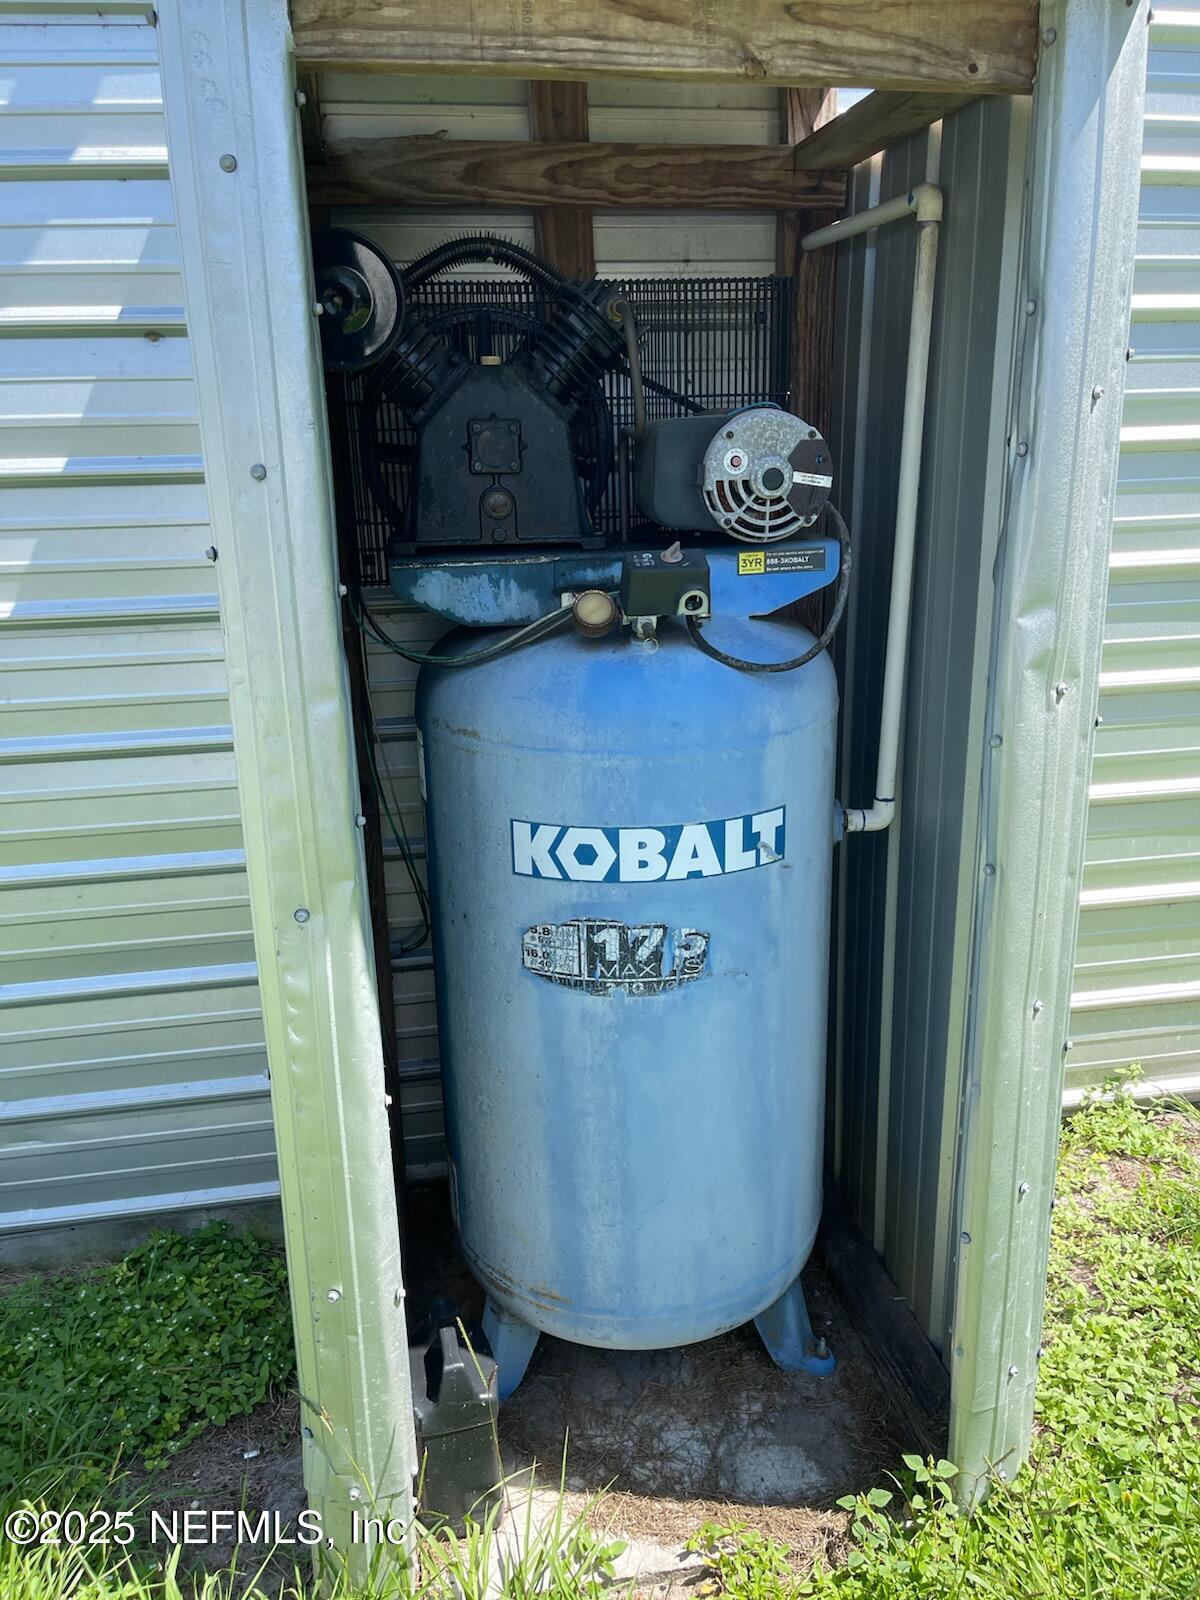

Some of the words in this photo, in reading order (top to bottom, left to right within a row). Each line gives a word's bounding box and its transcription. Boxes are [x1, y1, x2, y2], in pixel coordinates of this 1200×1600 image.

[741, 558, 762, 568] 3YR
[766, 556, 810, 565] 888-3KOBALT
[512, 808, 784, 882] KOBALT
[529, 927, 550, 936] 5.8
[525, 949, 549, 960] 16.0
[599, 962, 657, 977] MAX
